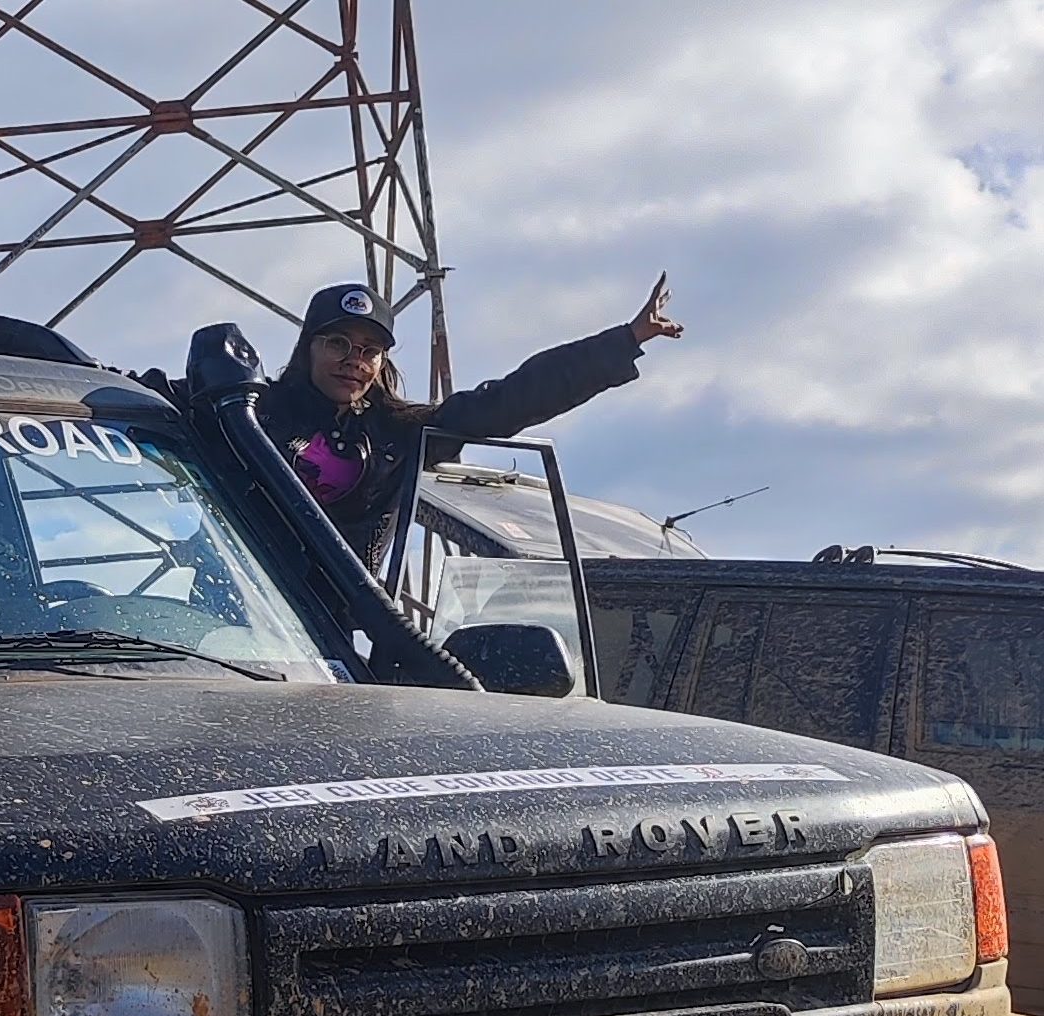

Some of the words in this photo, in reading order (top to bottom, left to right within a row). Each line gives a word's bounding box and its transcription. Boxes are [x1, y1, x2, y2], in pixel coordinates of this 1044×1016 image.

[242, 787, 312, 807] JEEP
[326, 779, 430, 800] CLUBE
[434, 770, 583, 792] COMANDO
[589, 766, 684, 784] OESTE
[583, 809, 808, 859] ROVER
